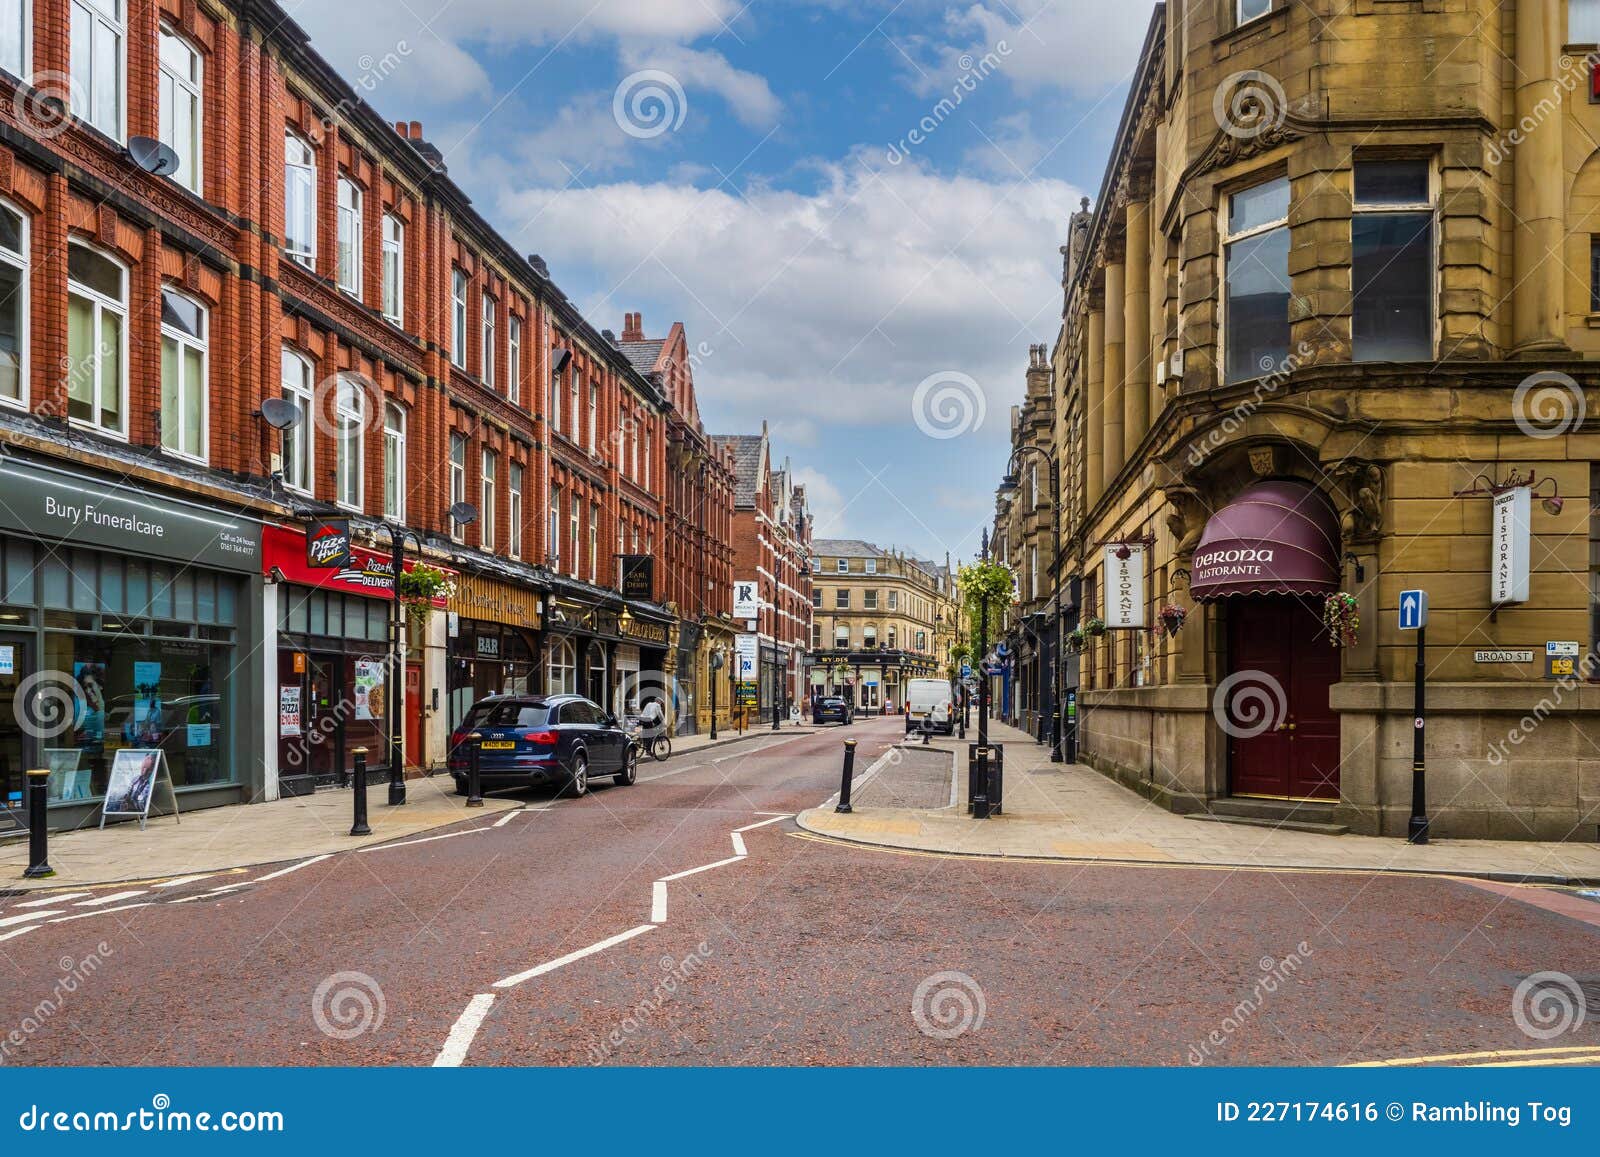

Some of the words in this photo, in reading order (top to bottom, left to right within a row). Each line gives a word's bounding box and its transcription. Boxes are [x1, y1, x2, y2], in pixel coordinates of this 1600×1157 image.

[46, 496, 80, 525] Bury
[85, 505, 164, 537] Funeralcare
[311, 536, 347, 557] Pizza
[317, 545, 342, 561] Hut
[1500, 506, 1508, 598] RISTORANTE
[367, 557, 385, 571] Pizza
[1199, 565, 1261, 580] RISTORANTE
[362, 576, 394, 588] DELIVERY
[478, 636, 498, 654] BAR
[1477, 652, 1513, 661] BROAD
[1517, 652, 1530, 661] ST
[282, 703, 299, 714] PIZZA
